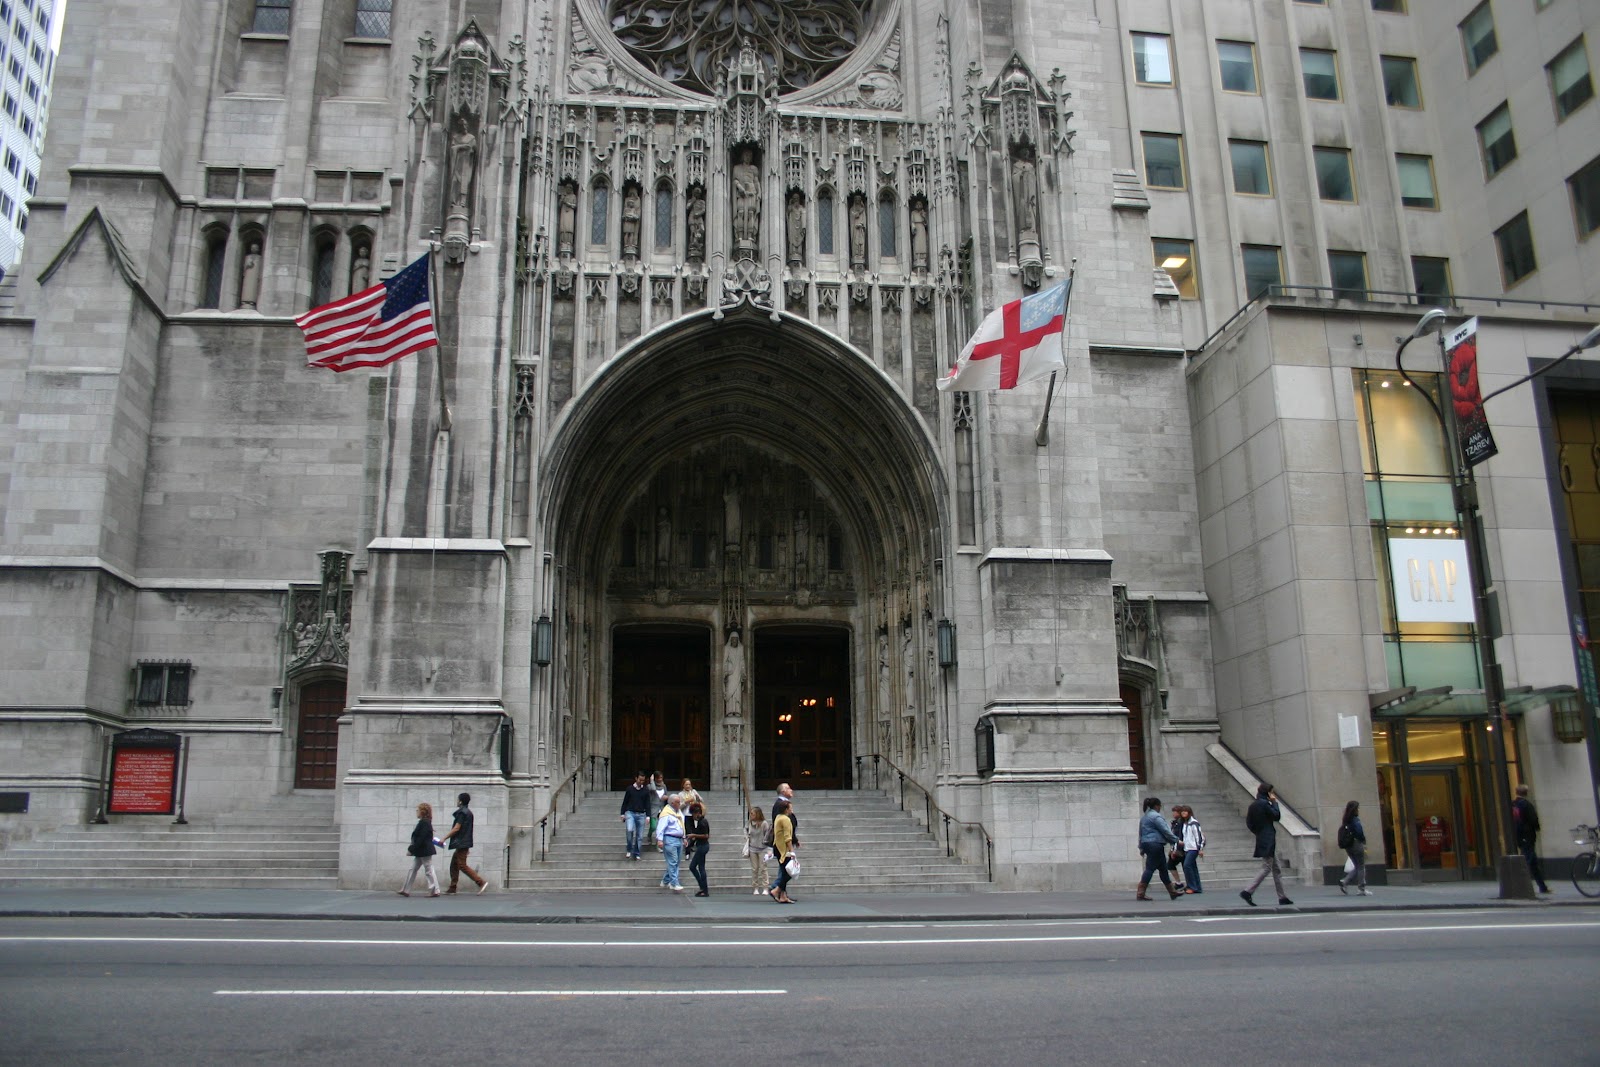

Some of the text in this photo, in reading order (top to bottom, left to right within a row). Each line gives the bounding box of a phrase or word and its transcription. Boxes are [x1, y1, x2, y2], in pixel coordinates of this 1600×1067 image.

[1454, 328, 1468, 342] NYC
[1465, 437, 1490, 456] TZAREV
[1469, 432, 1482, 445] ANA
[1407, 558, 1457, 603] GAP
